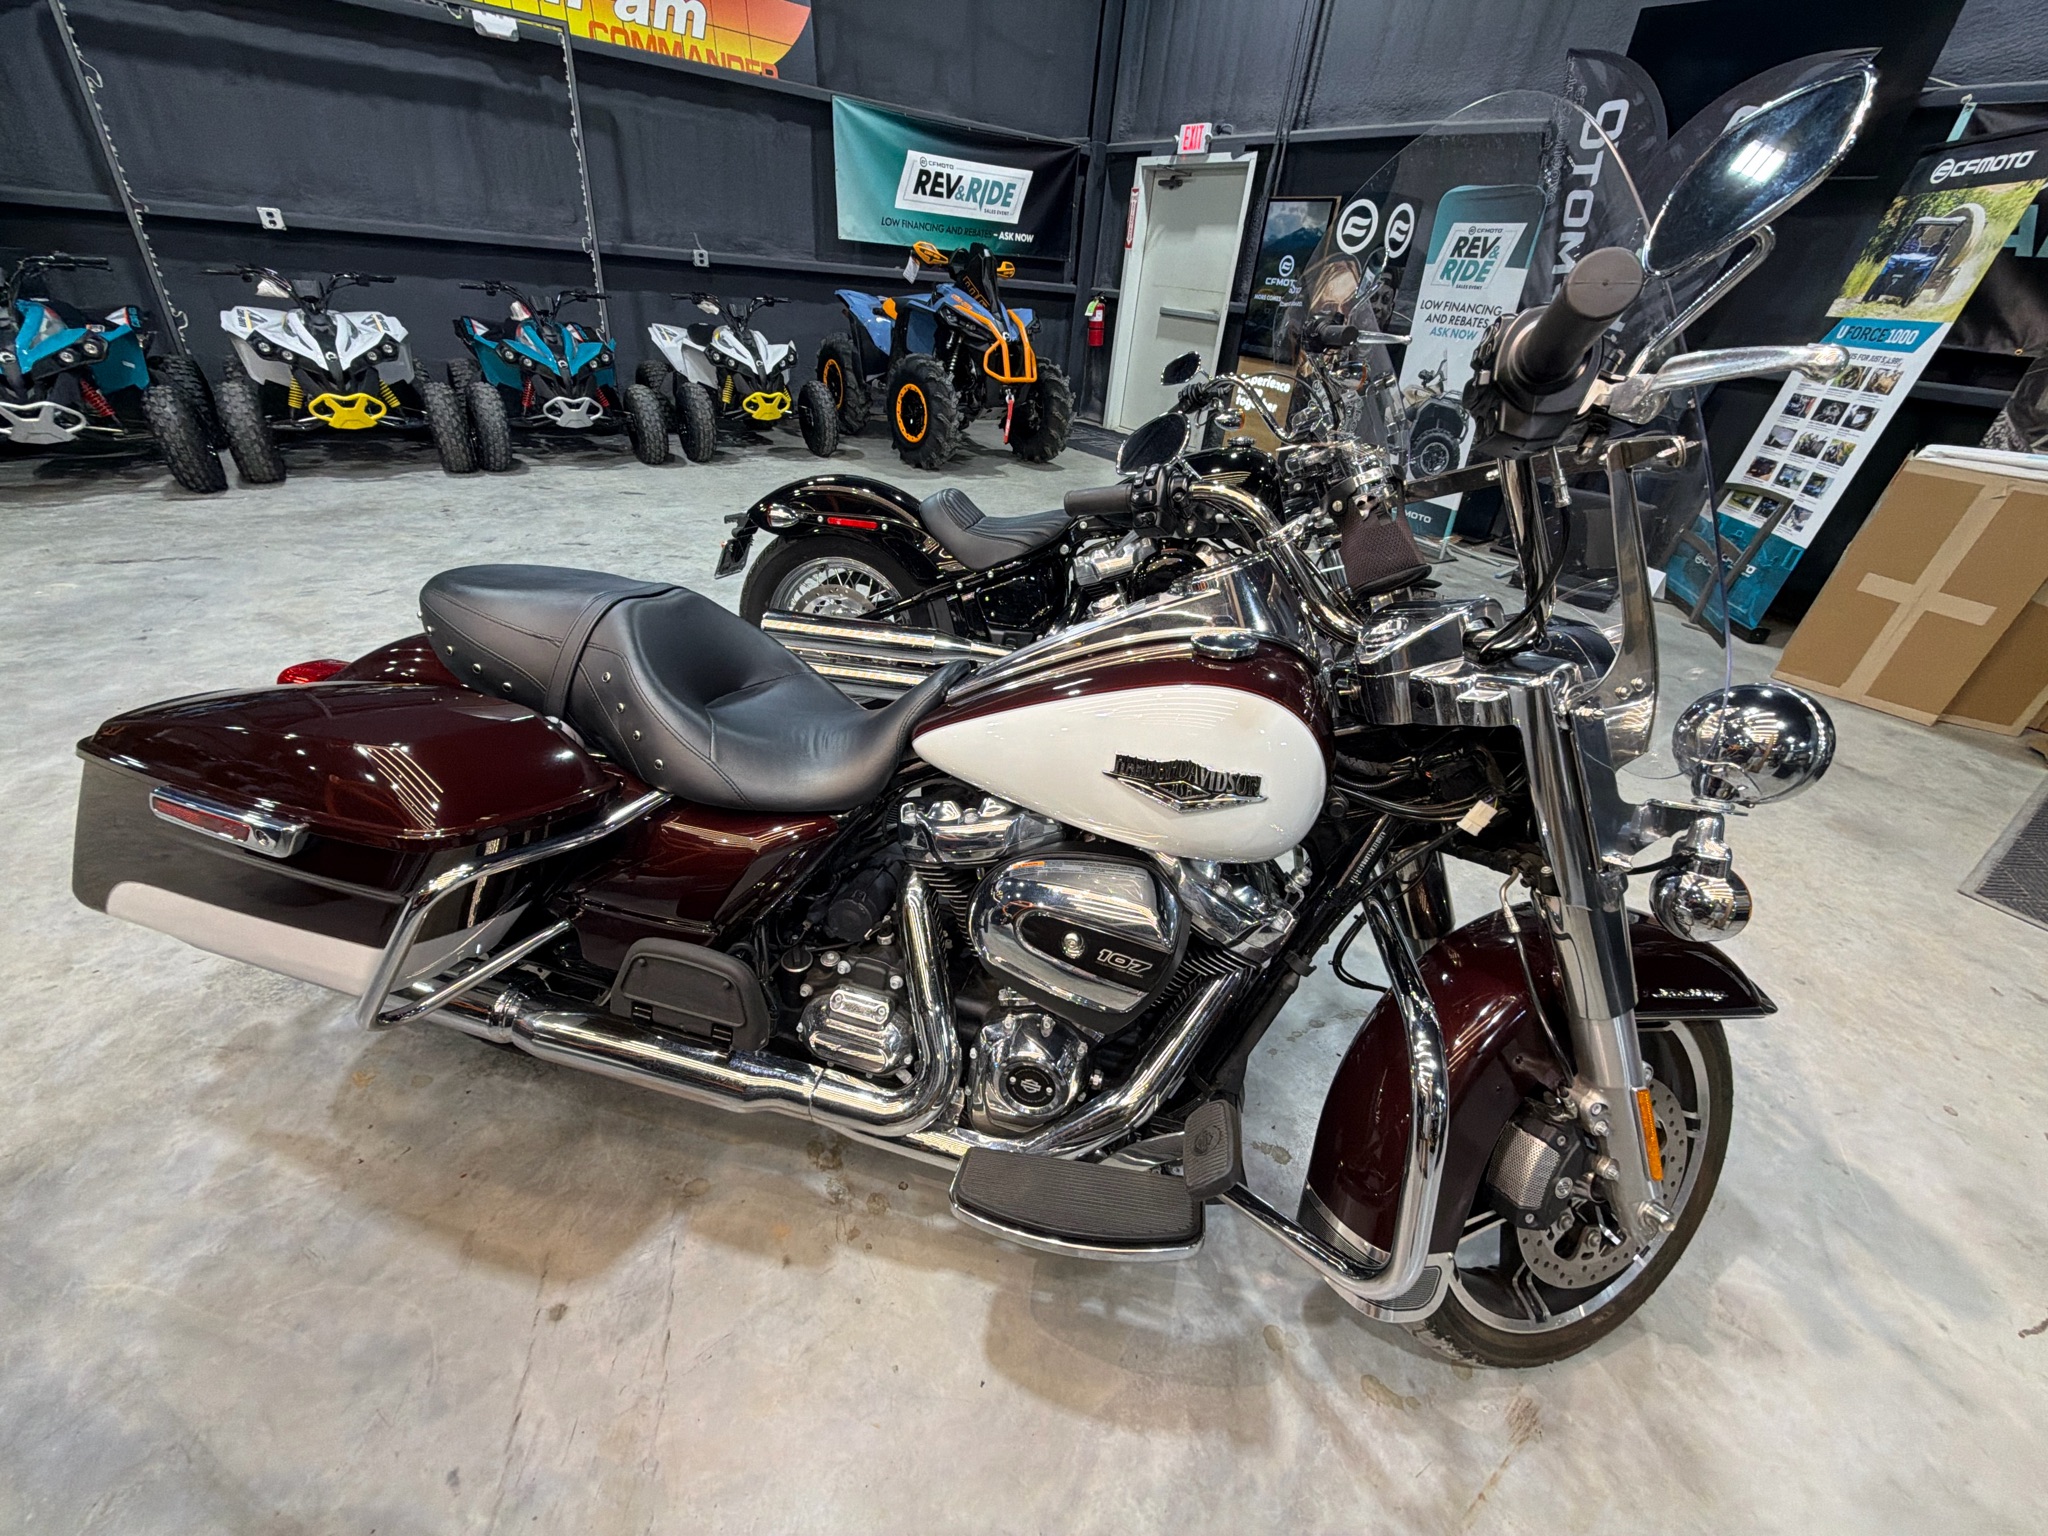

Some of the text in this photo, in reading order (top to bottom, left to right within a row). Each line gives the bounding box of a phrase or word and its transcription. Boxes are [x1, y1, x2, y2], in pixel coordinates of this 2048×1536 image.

[1183, 125, 1205, 150] EXIT
[928, 160, 954, 170] CFMOTO
[1950, 150, 2039, 177] CFMOTO
[881, 217, 900, 227] LOW
[901, 219, 945, 233] FINANCING
[946, 225, 964, 235] AND
[964, 227, 993, 239] REBATES
[998, 232, 1014, 241] ASK
[1015, 232, 1034, 243] NOW
[1440, 259, 1495, 287] RIDE
[1420, 300, 1502, 316] LOW FINANCING
[1425, 314, 1490, 328] AND REBATES
[1430, 327, 1479, 340] ASK NOW
[1097, 949, 1153, 973] 107
